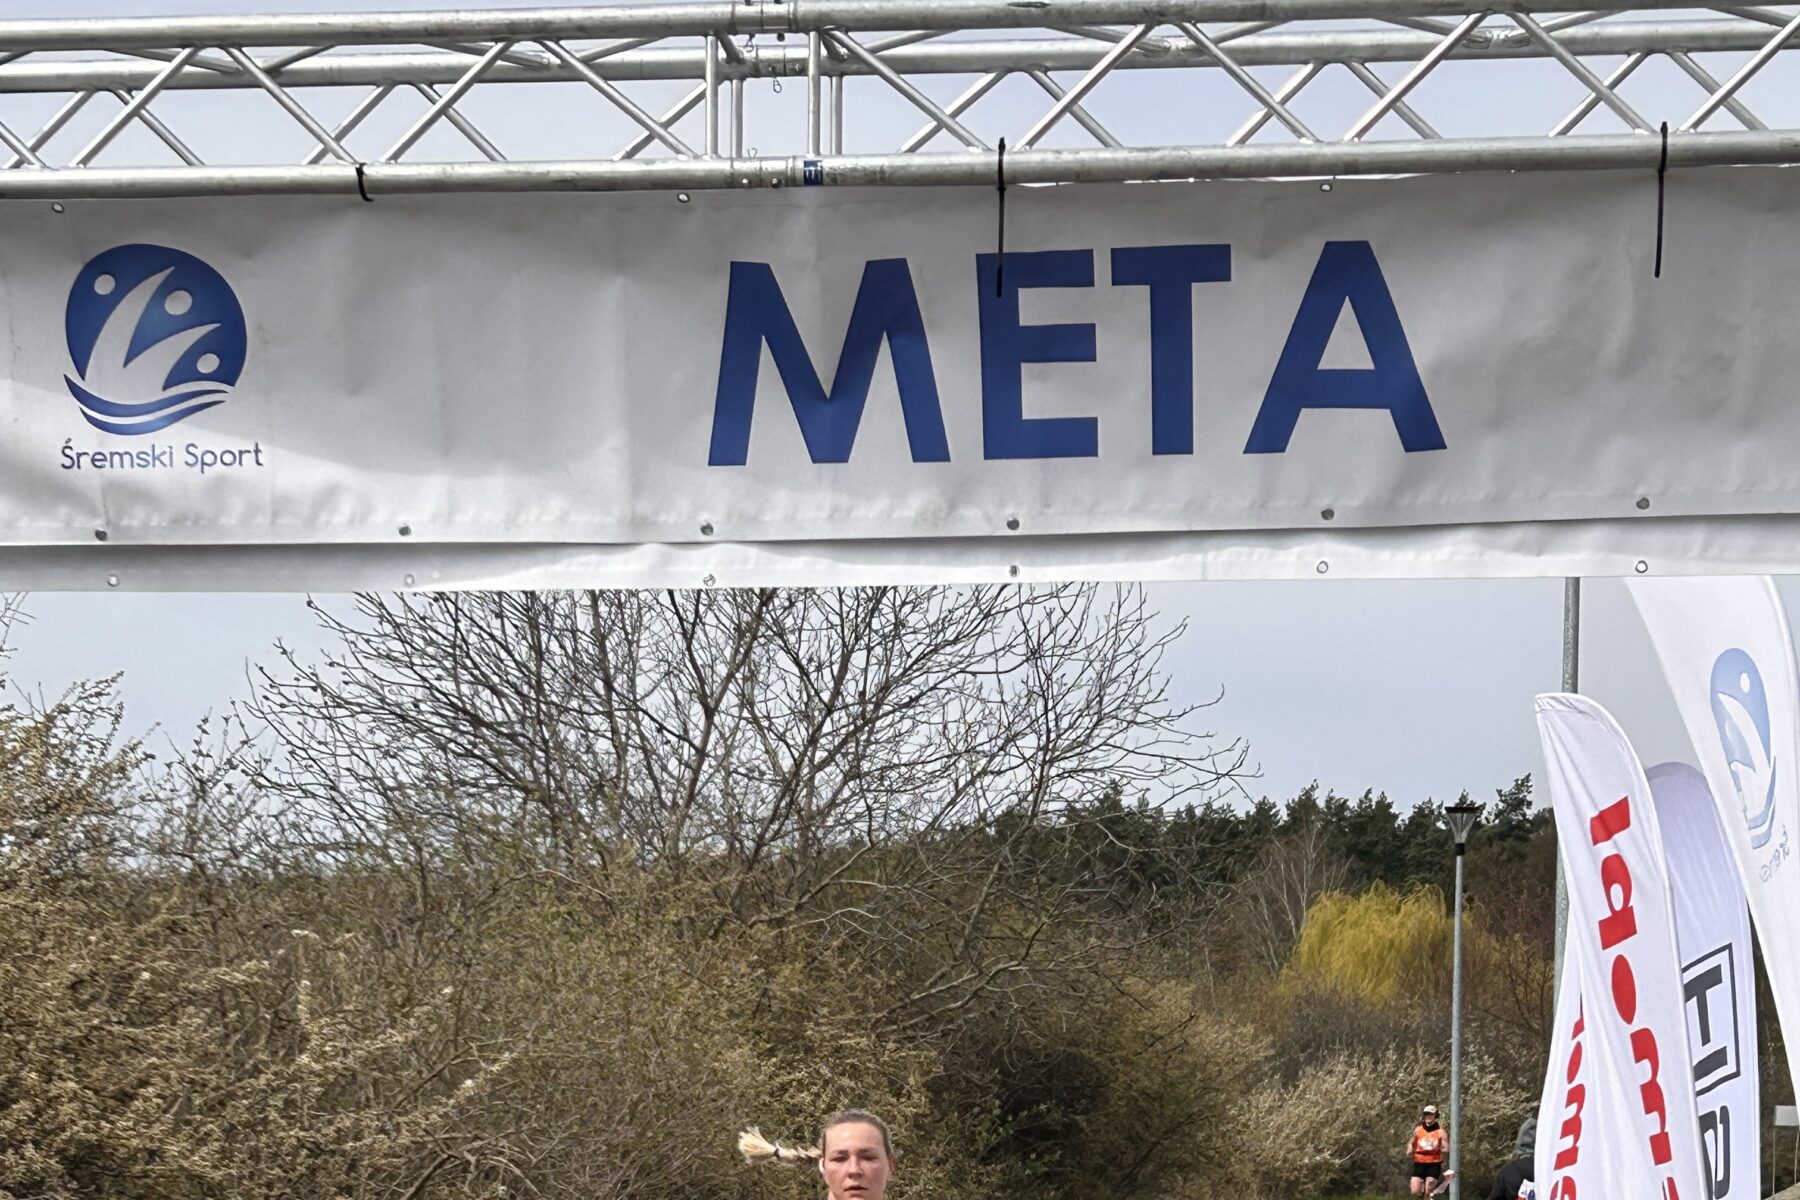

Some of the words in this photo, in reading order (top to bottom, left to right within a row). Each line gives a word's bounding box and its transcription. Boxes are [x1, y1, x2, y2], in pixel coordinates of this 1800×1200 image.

[708, 240, 1446, 466] META
[61, 438, 174, 469] Śremski
[184, 443, 264, 474] Sport
